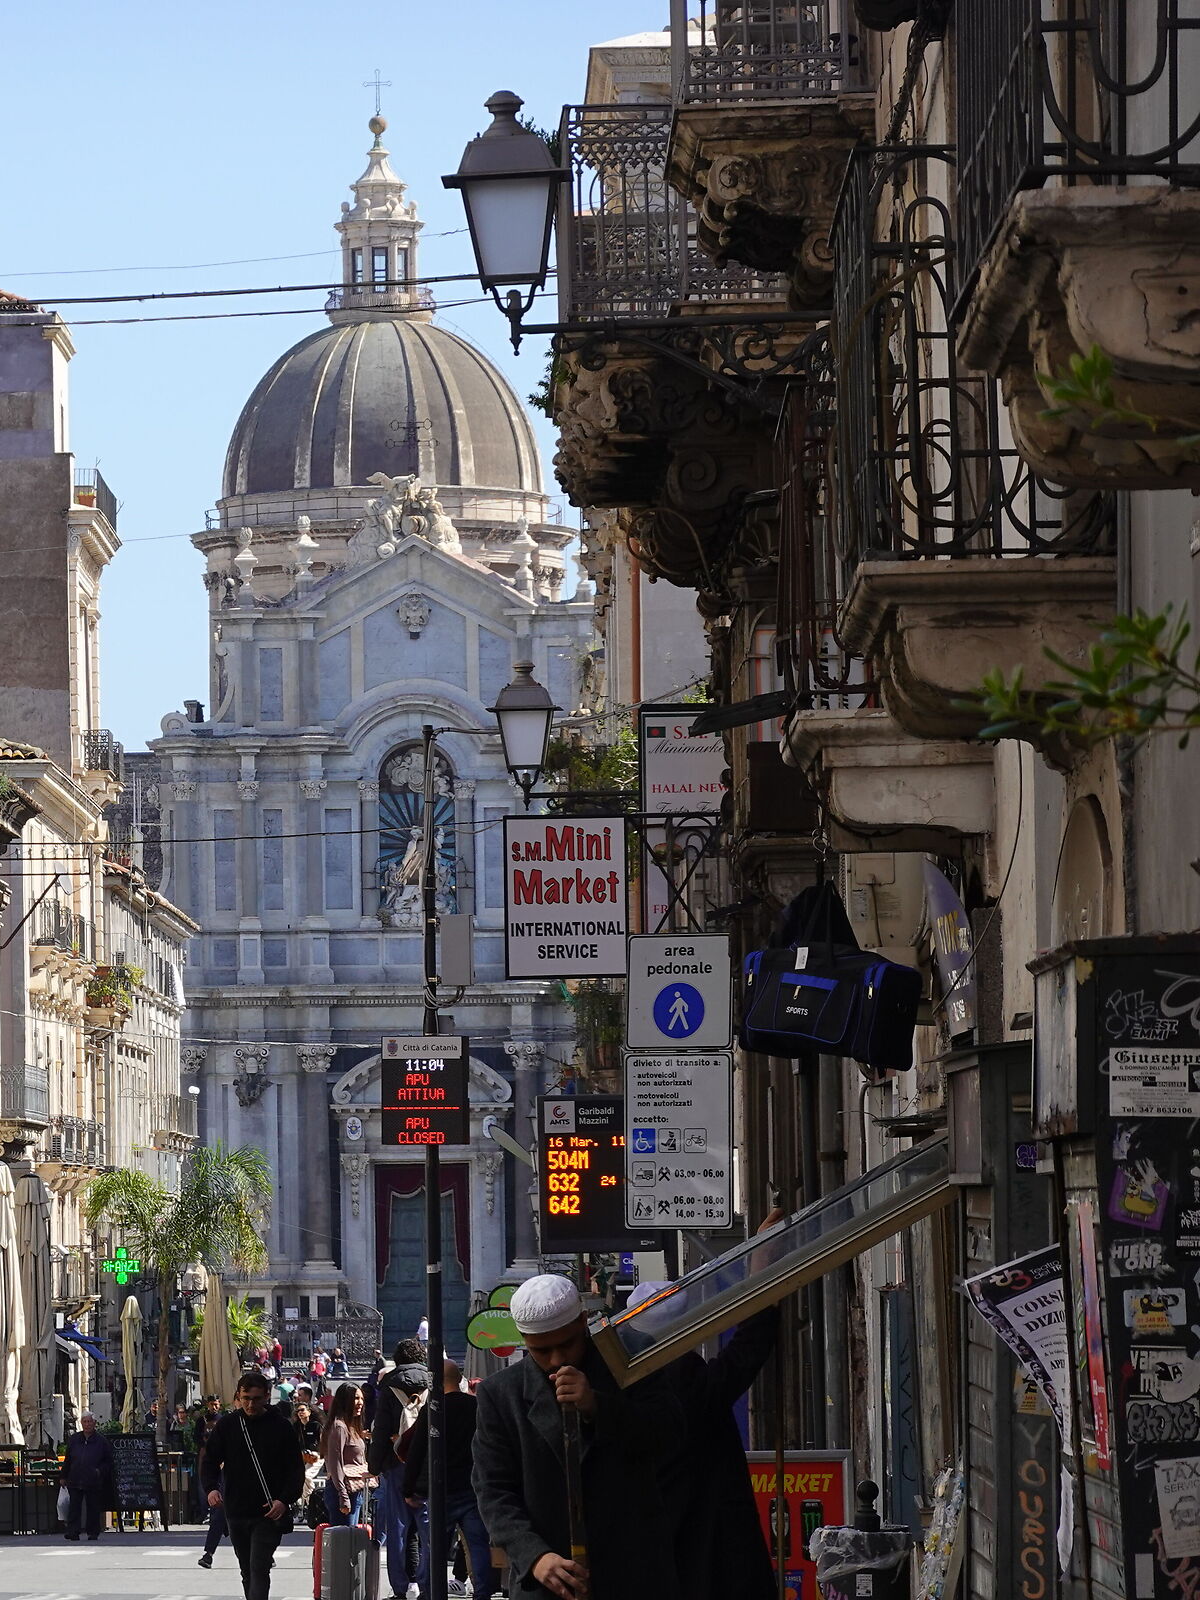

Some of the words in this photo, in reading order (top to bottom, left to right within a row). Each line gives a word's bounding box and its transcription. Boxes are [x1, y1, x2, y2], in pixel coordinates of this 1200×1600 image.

[651, 783, 695, 793] HALAL
[511, 841, 546, 862] S.M.
[545, 825, 612, 862] Mini
[513, 868, 620, 906] Market
[510, 920, 625, 937] INTERNATIONAL
[537, 943, 599, 959] SERVICE
[664, 945, 695, 957] area
[647, 962, 713, 977] pedonale
[785, 1005, 810, 1017] SPORTS
[402, 1043, 421, 1052] Città
[422, 1044, 429, 1052] di
[430, 1044, 458, 1052] Catania
[405, 1059, 445, 1072] 11:04
[633, 1059, 662, 1068] divieto
[665, 1059, 673, 1067] di
[676, 1058, 711, 1067] transito
[405, 1073, 430, 1086] APU
[637, 1071, 677, 1080] autoveicoli
[653, 1079, 693, 1087] autorizzati
[397, 1088, 446, 1101] ATTIVA
[637, 1092, 679, 1100] motoveicoli
[578, 1107, 615, 1117] Garibaldi
[405, 1117, 430, 1130] APU
[549, 1118, 571, 1126] AMTS
[579, 1116, 610, 1125] Mazzini
[633, 1115, 669, 1124] eccetto:
[397, 1132, 446, 1145] CLOSED
[548, 1136, 564, 1148] 16
[570, 1136, 599, 1147] Mar.
[547, 1149, 589, 1170] 504M
[674, 1168, 696, 1179] 03.00
[703, 1167, 725, 1179] 06.00
[547, 1172, 581, 1193] 632
[600, 1175, 617, 1187] 24
[547, 1194, 581, 1215] 642
[673, 1194, 696, 1206] 06.00
[703, 1194, 725, 1205] 08.00
[675, 1208, 696, 1219] 14.00
[704, 1207, 725, 1219] 15.30
